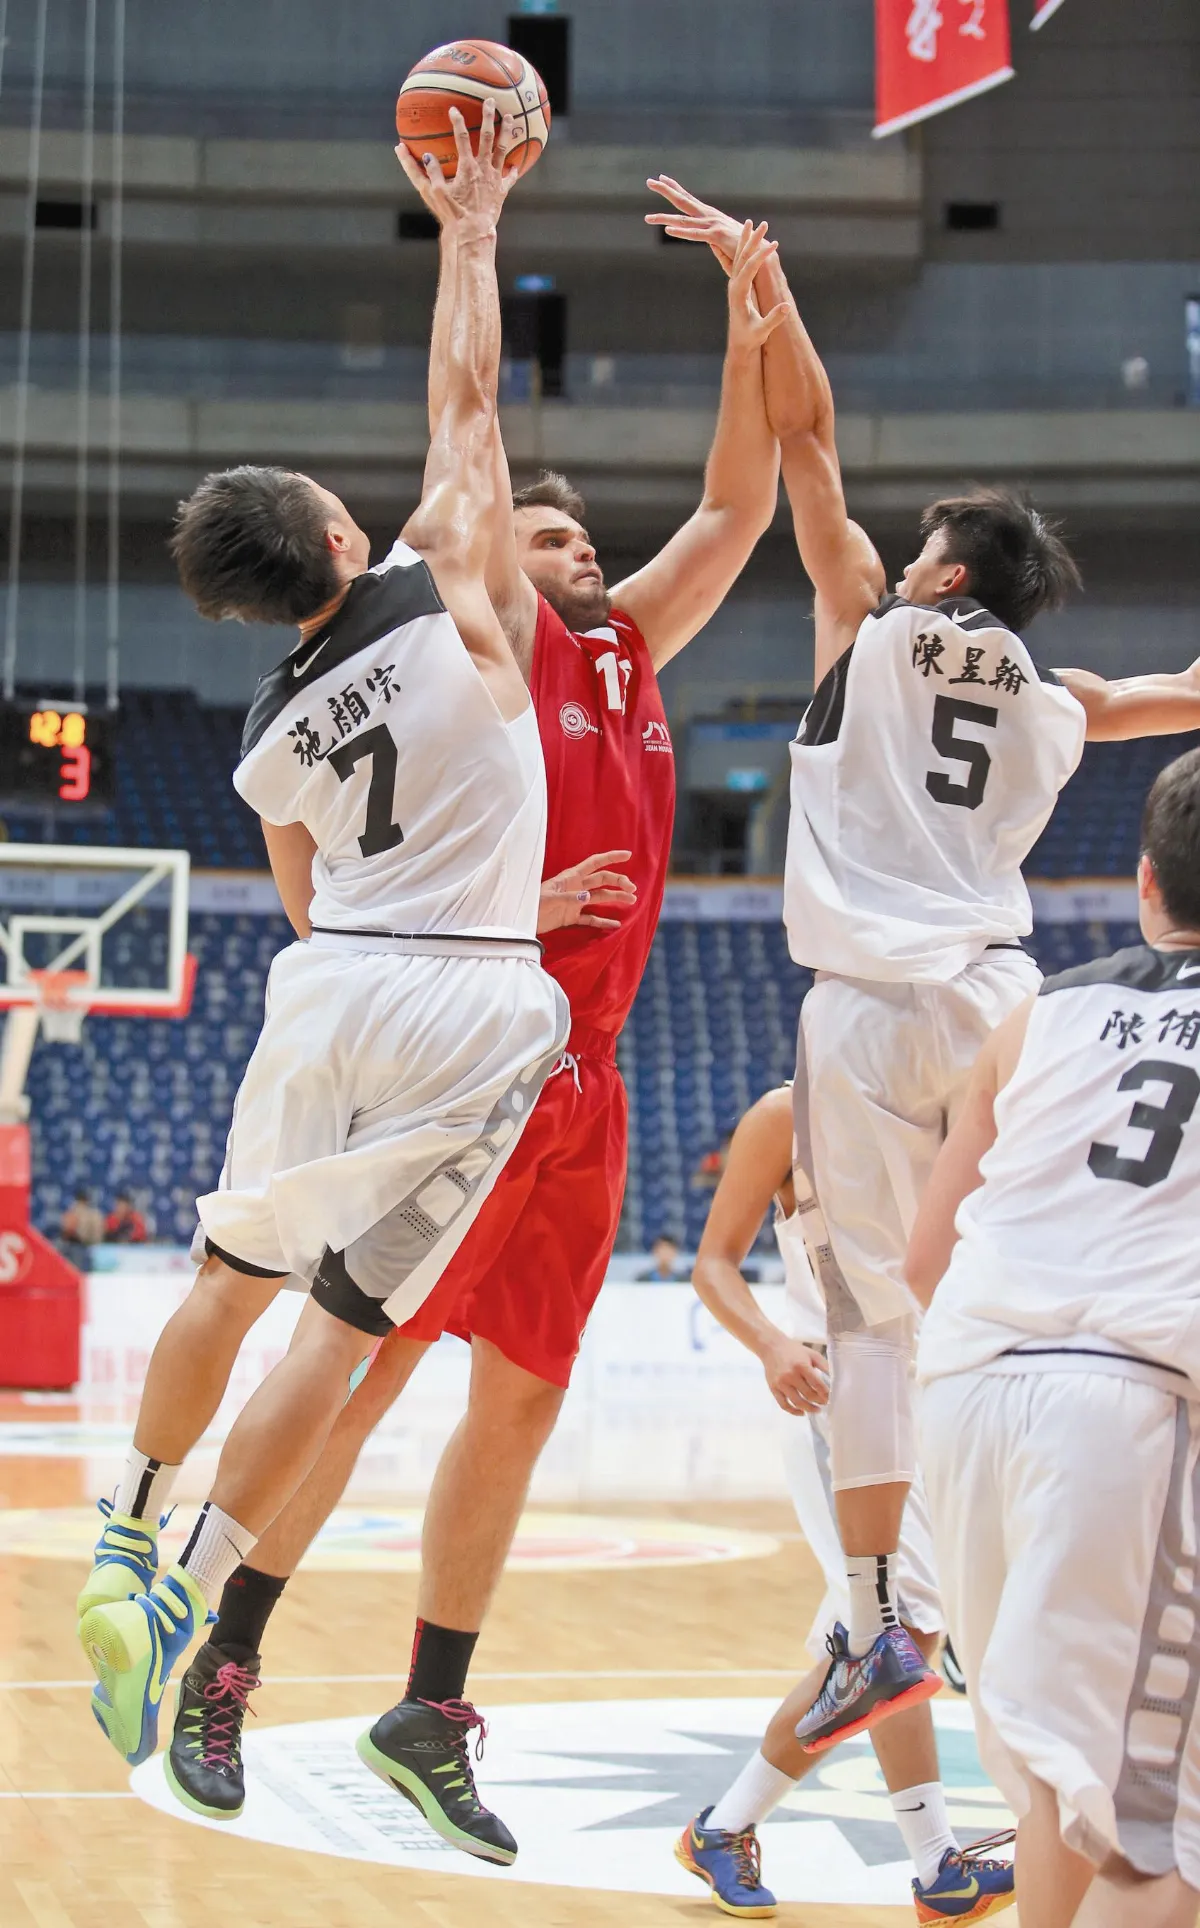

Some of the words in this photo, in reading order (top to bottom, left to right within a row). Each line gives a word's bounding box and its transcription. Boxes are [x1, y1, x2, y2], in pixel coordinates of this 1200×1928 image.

[912, 633, 1030, 696] 陳昱翰
[59, 745, 91, 801] 3
[326, 722, 405, 859] 7
[925, 693, 999, 811] 5
[1087, 1059, 1200, 1188] 3
